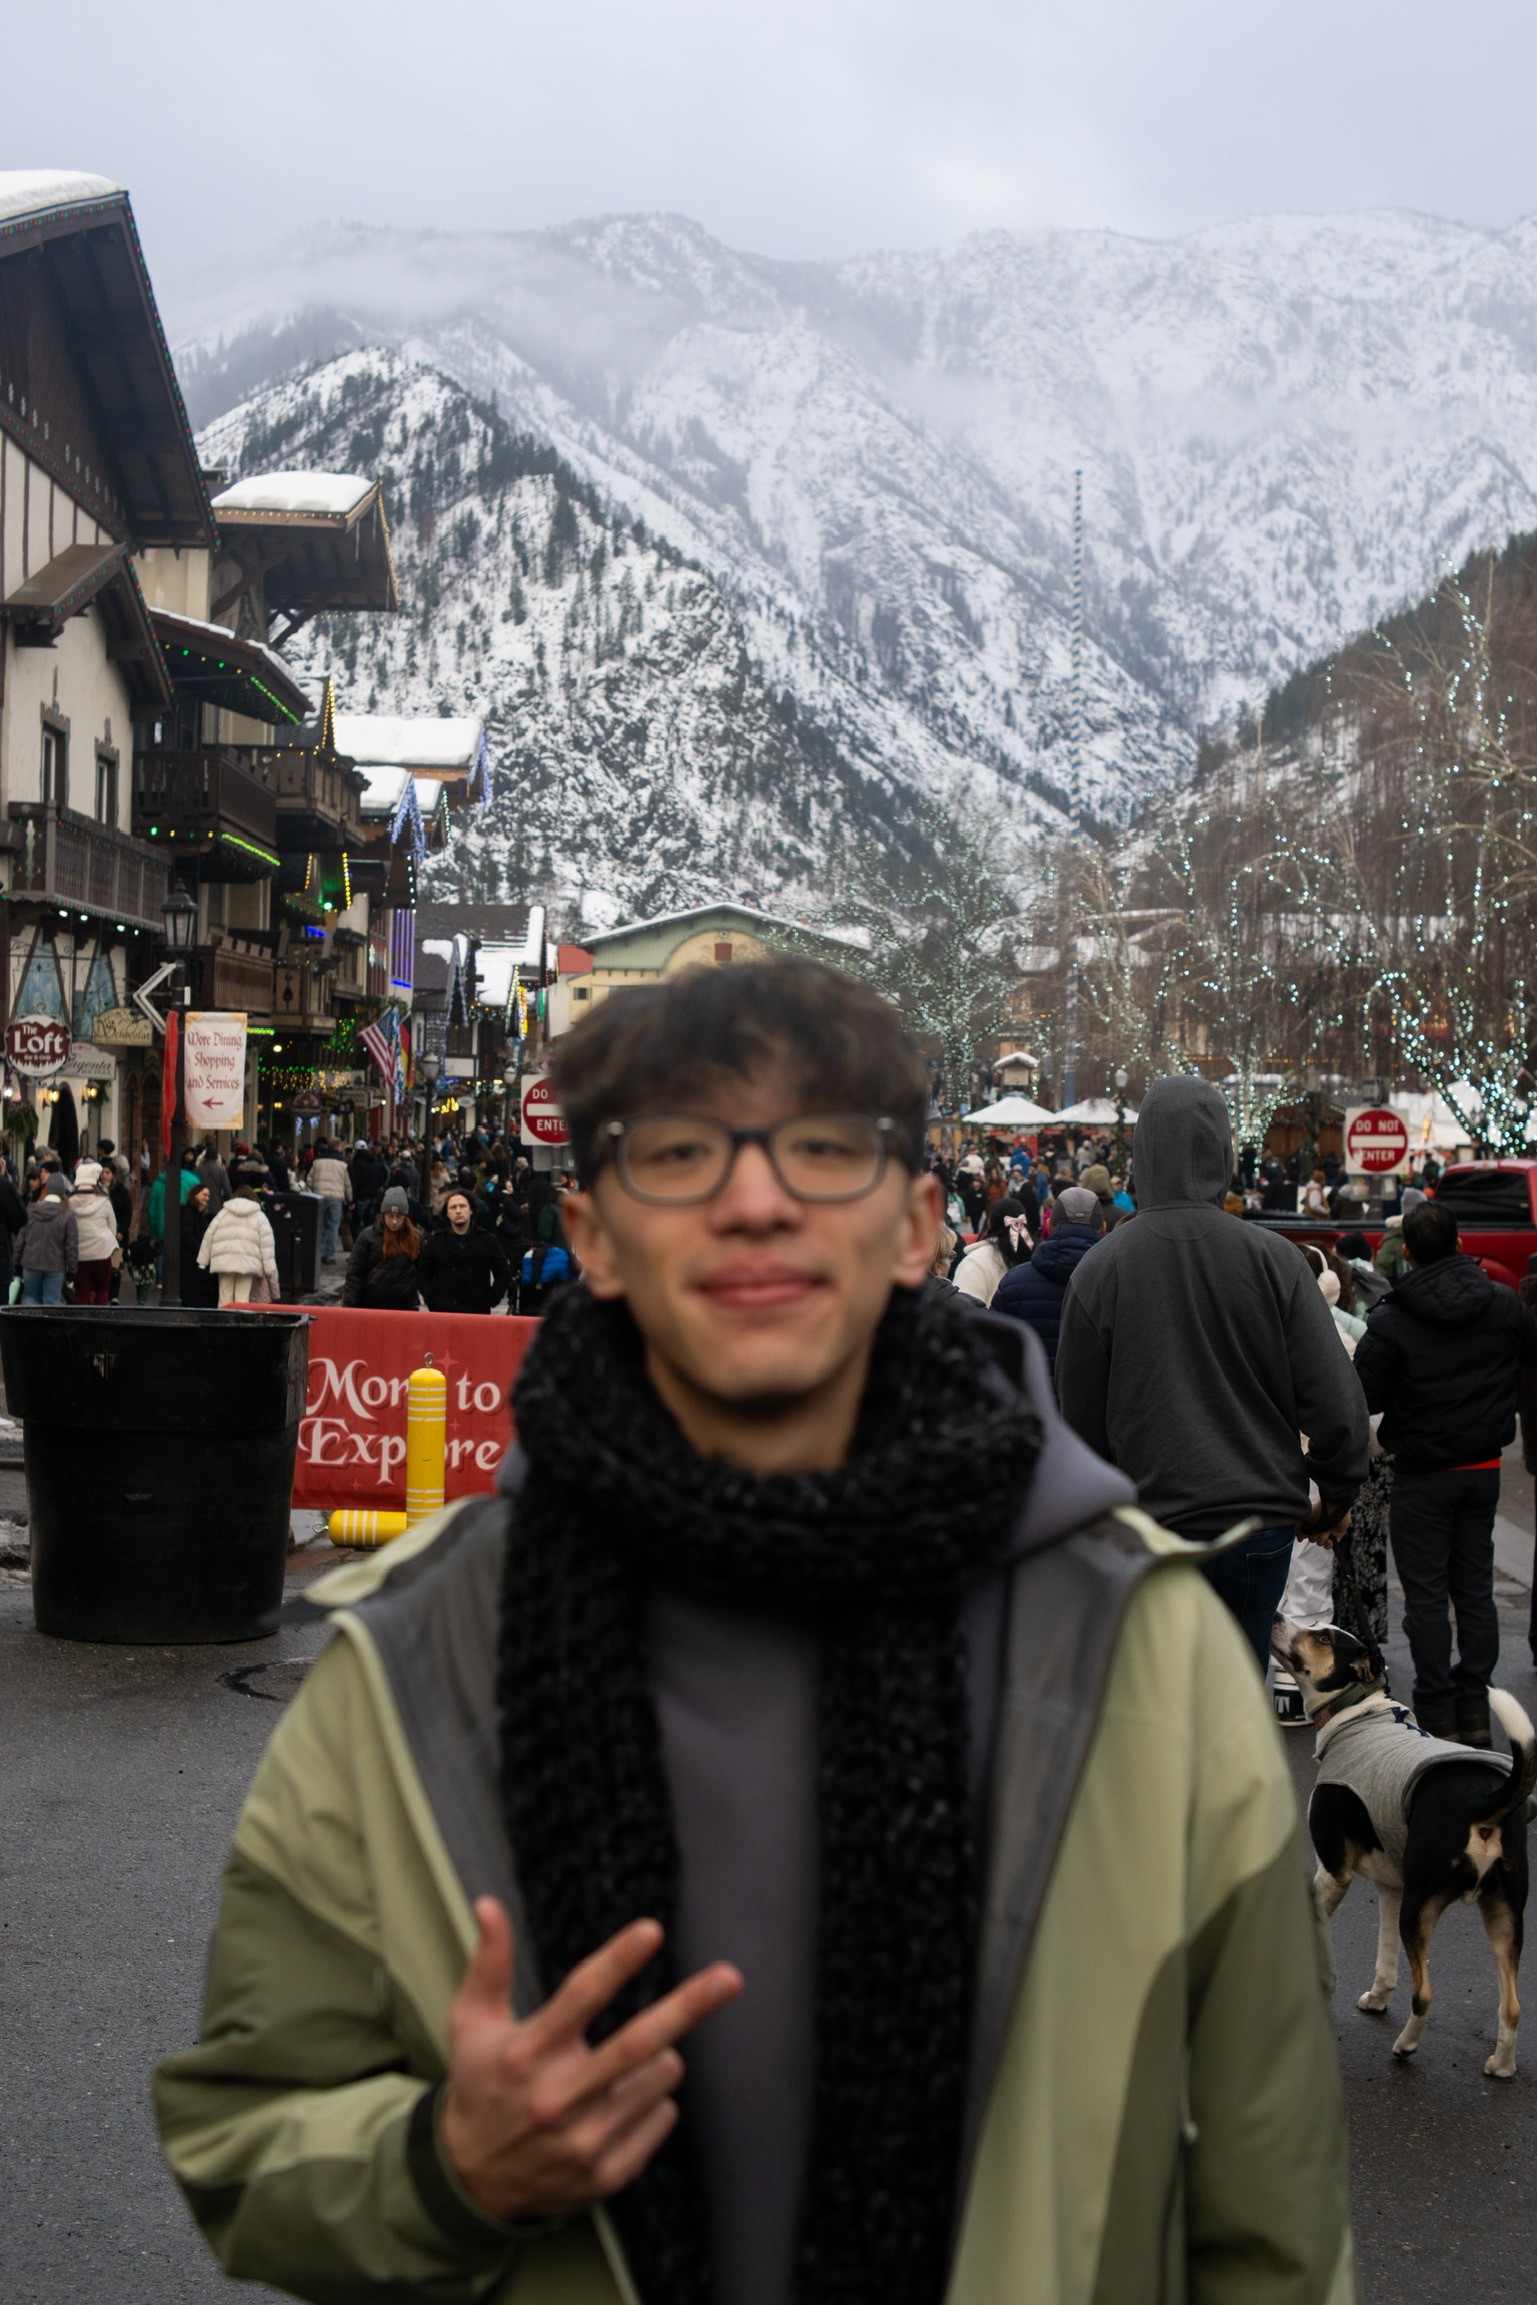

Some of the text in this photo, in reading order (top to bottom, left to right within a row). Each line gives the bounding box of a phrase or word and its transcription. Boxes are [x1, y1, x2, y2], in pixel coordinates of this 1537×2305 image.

[22, 1024, 38, 1036] The
[14, 1030, 64, 1054] Loft
[187, 1031, 211, 1046] More
[194, 1051, 236, 1071] Shopping
[187, 1074, 240, 1090] and Services
[532, 1088, 548, 1100] DO
[536, 1119, 569, 1132] ENTE
[1355, 1119, 1399, 1133] DO NOT
[1362, 1149, 1395, 1162] ENTER
[306, 1357, 501, 1420] Mor to
[298, 1417, 501, 1486] Expre
